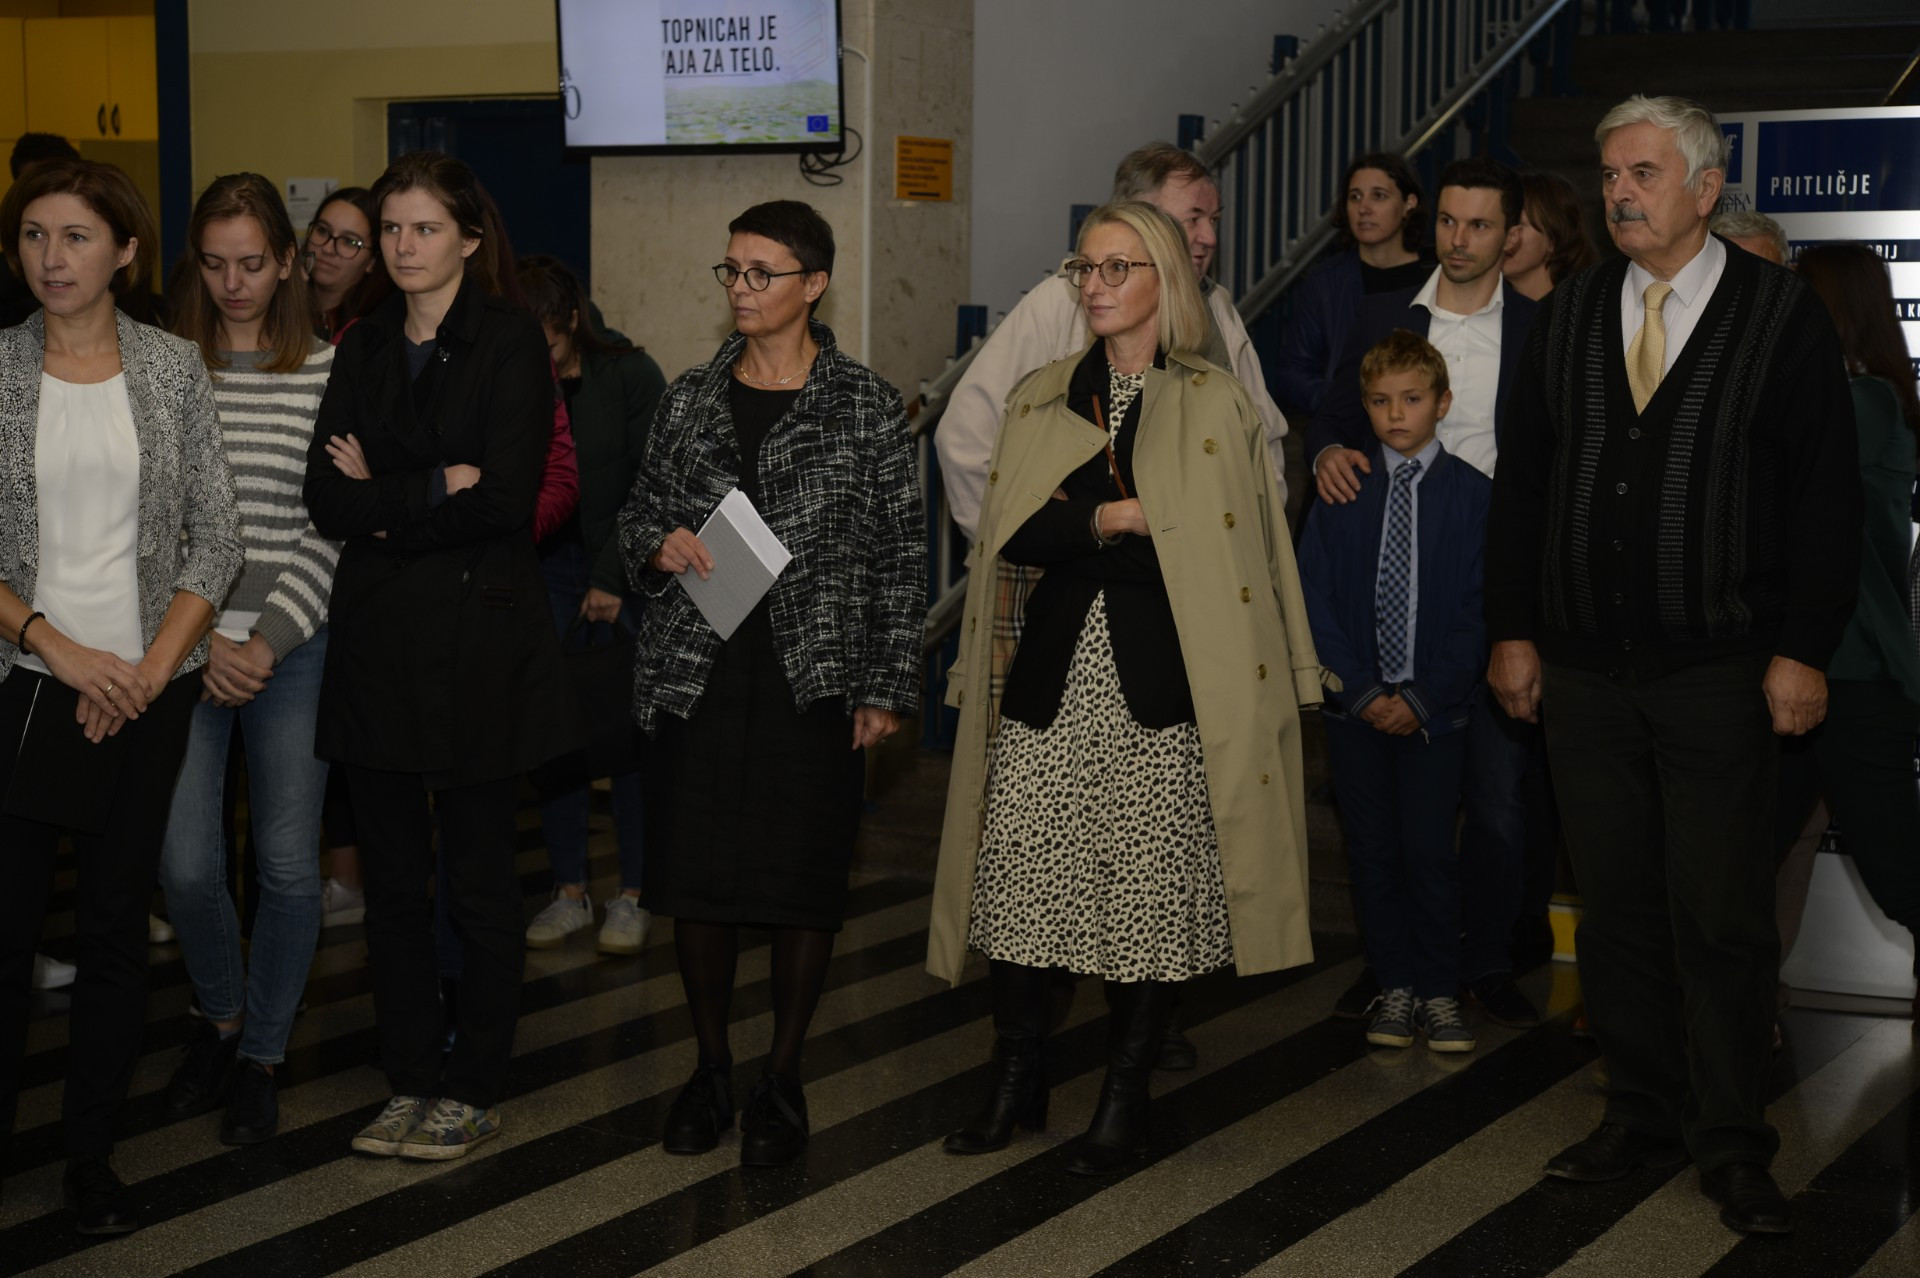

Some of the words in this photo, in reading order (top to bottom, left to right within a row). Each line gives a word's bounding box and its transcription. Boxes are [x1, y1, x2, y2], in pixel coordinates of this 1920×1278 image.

[662, 17, 750, 43] TOPNICAH
[758, 15, 777, 41] JE
[662, 49, 697, 74] AJA
[703, 48, 724, 73] ZA
[730, 46, 780, 72] TELO.
[1770, 169, 1871, 197] PRITLIČJE
